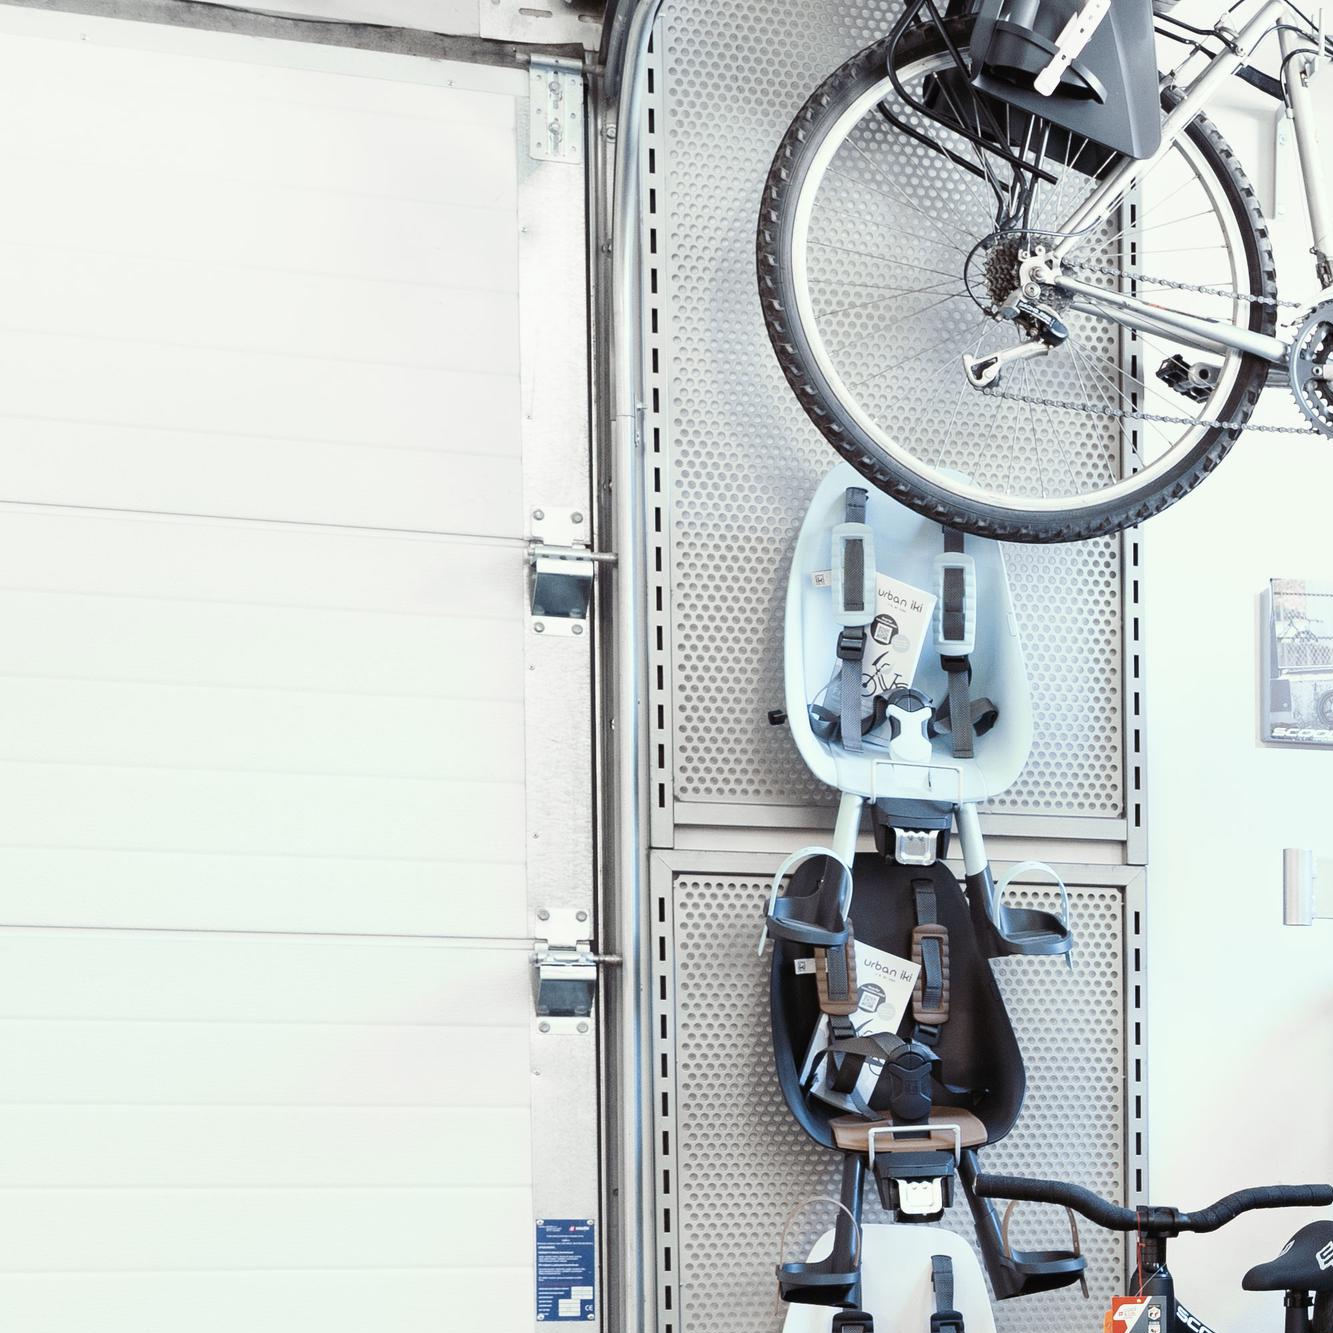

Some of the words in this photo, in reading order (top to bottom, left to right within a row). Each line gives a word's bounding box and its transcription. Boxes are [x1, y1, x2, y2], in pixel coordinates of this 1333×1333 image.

[878, 587, 908, 608] urban
[910, 600, 923, 614] iki
[863, 957, 897, 978] urban
[900, 966, 912, 982] iki
